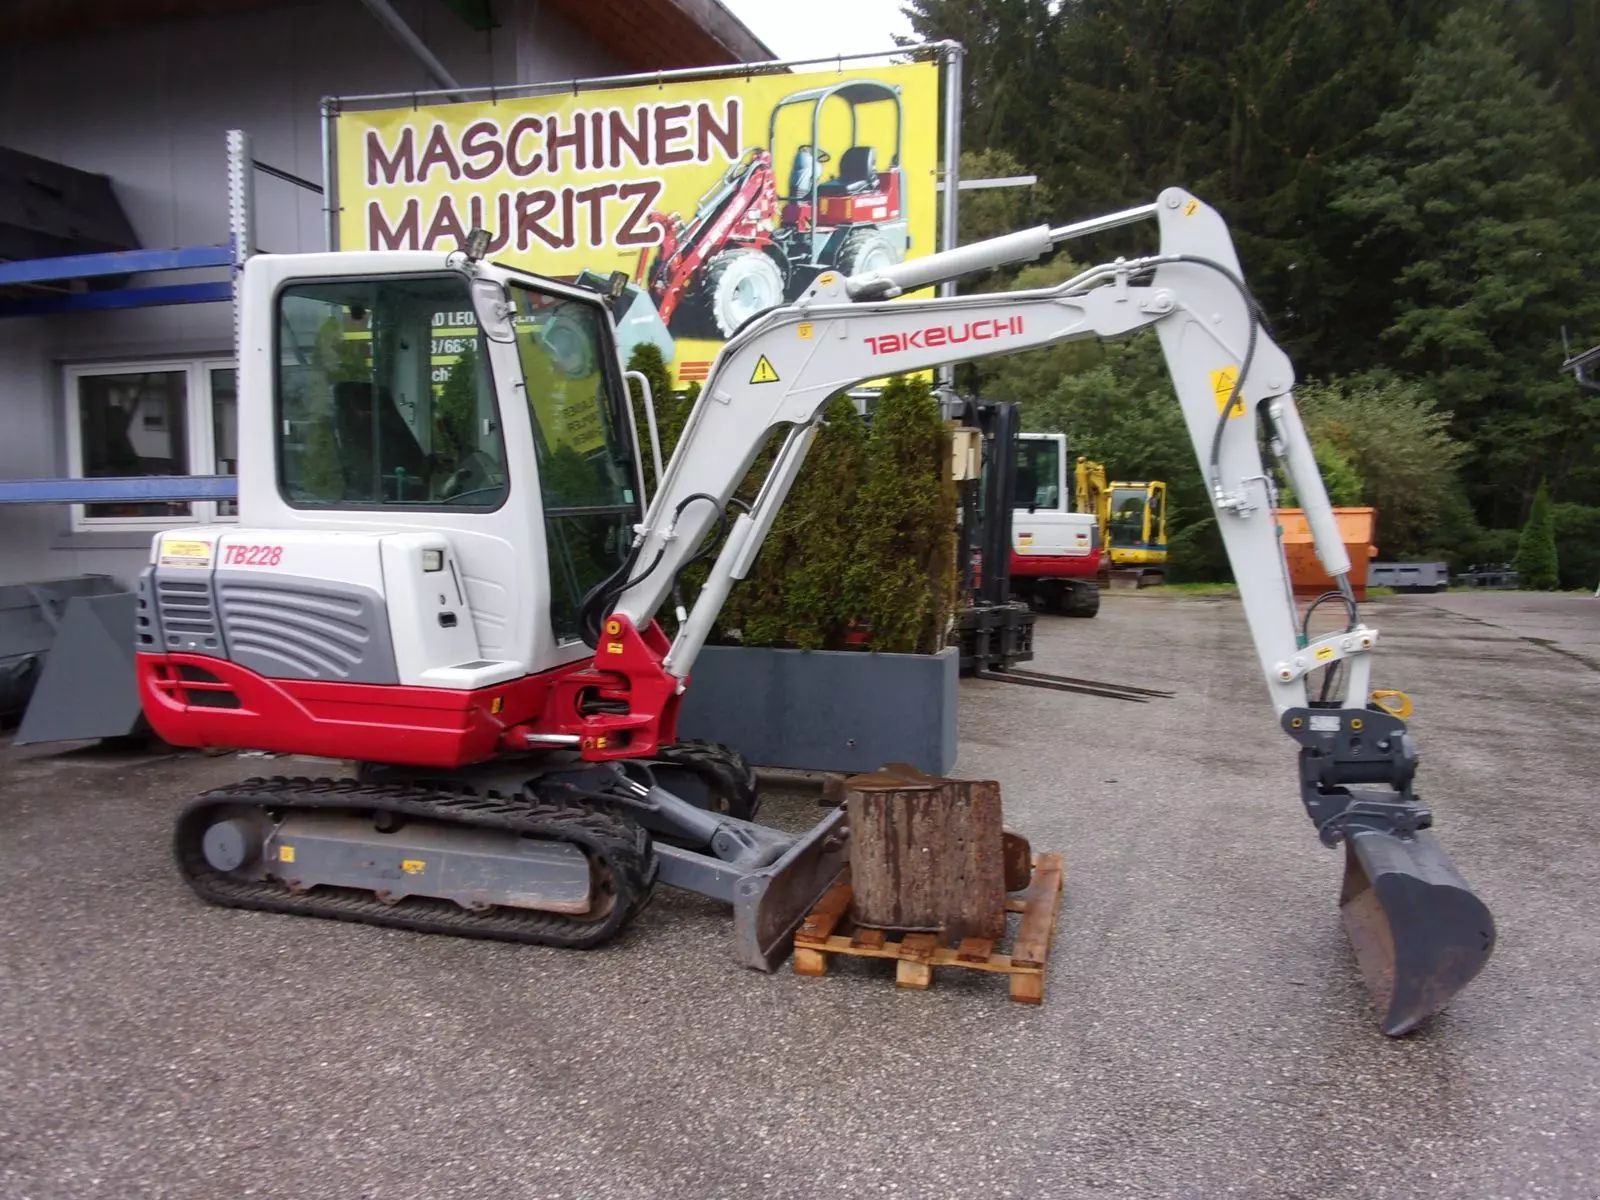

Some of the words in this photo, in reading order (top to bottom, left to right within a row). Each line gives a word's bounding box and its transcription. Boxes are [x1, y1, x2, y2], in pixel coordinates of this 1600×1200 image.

[366, 99, 739, 186] MASCHINEN
[368, 181, 663, 252] MAURITZ
[864, 315, 1024, 356] TAKEUCHI
[223, 543, 284, 567] TB228
